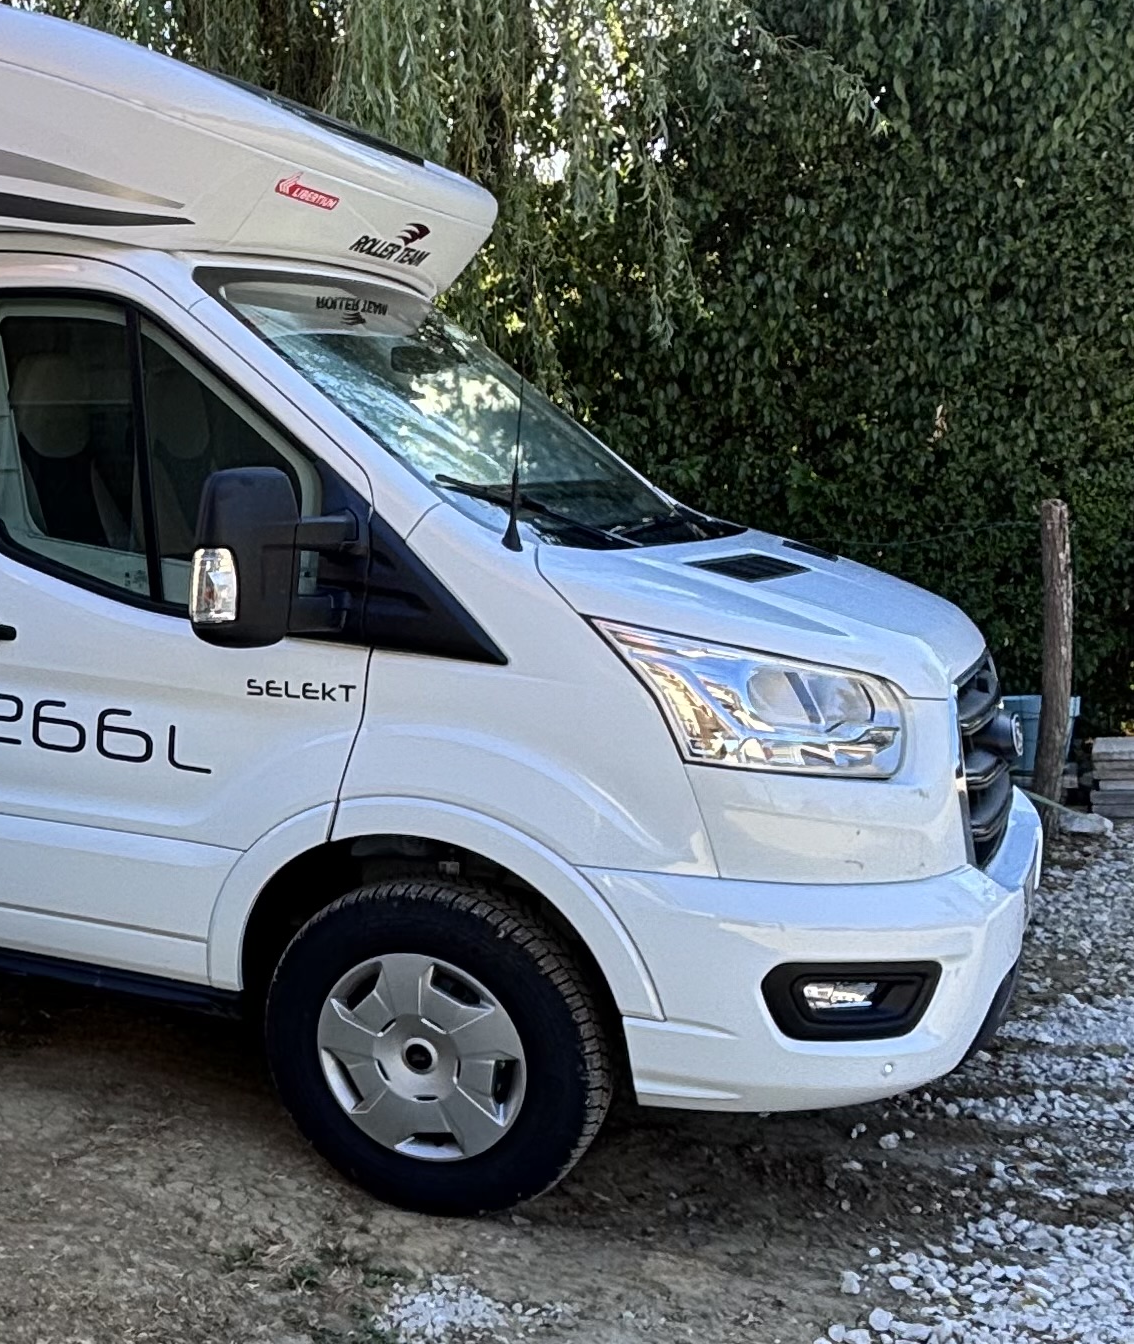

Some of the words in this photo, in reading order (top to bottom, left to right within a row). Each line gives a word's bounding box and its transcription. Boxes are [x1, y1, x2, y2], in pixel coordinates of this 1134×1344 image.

[291, 187, 338, 209] LIBERTIUM
[348, 235, 401, 261] ROLLER
[393, 247, 431, 267] TEAM
[246, 678, 357, 703] SELEKT
